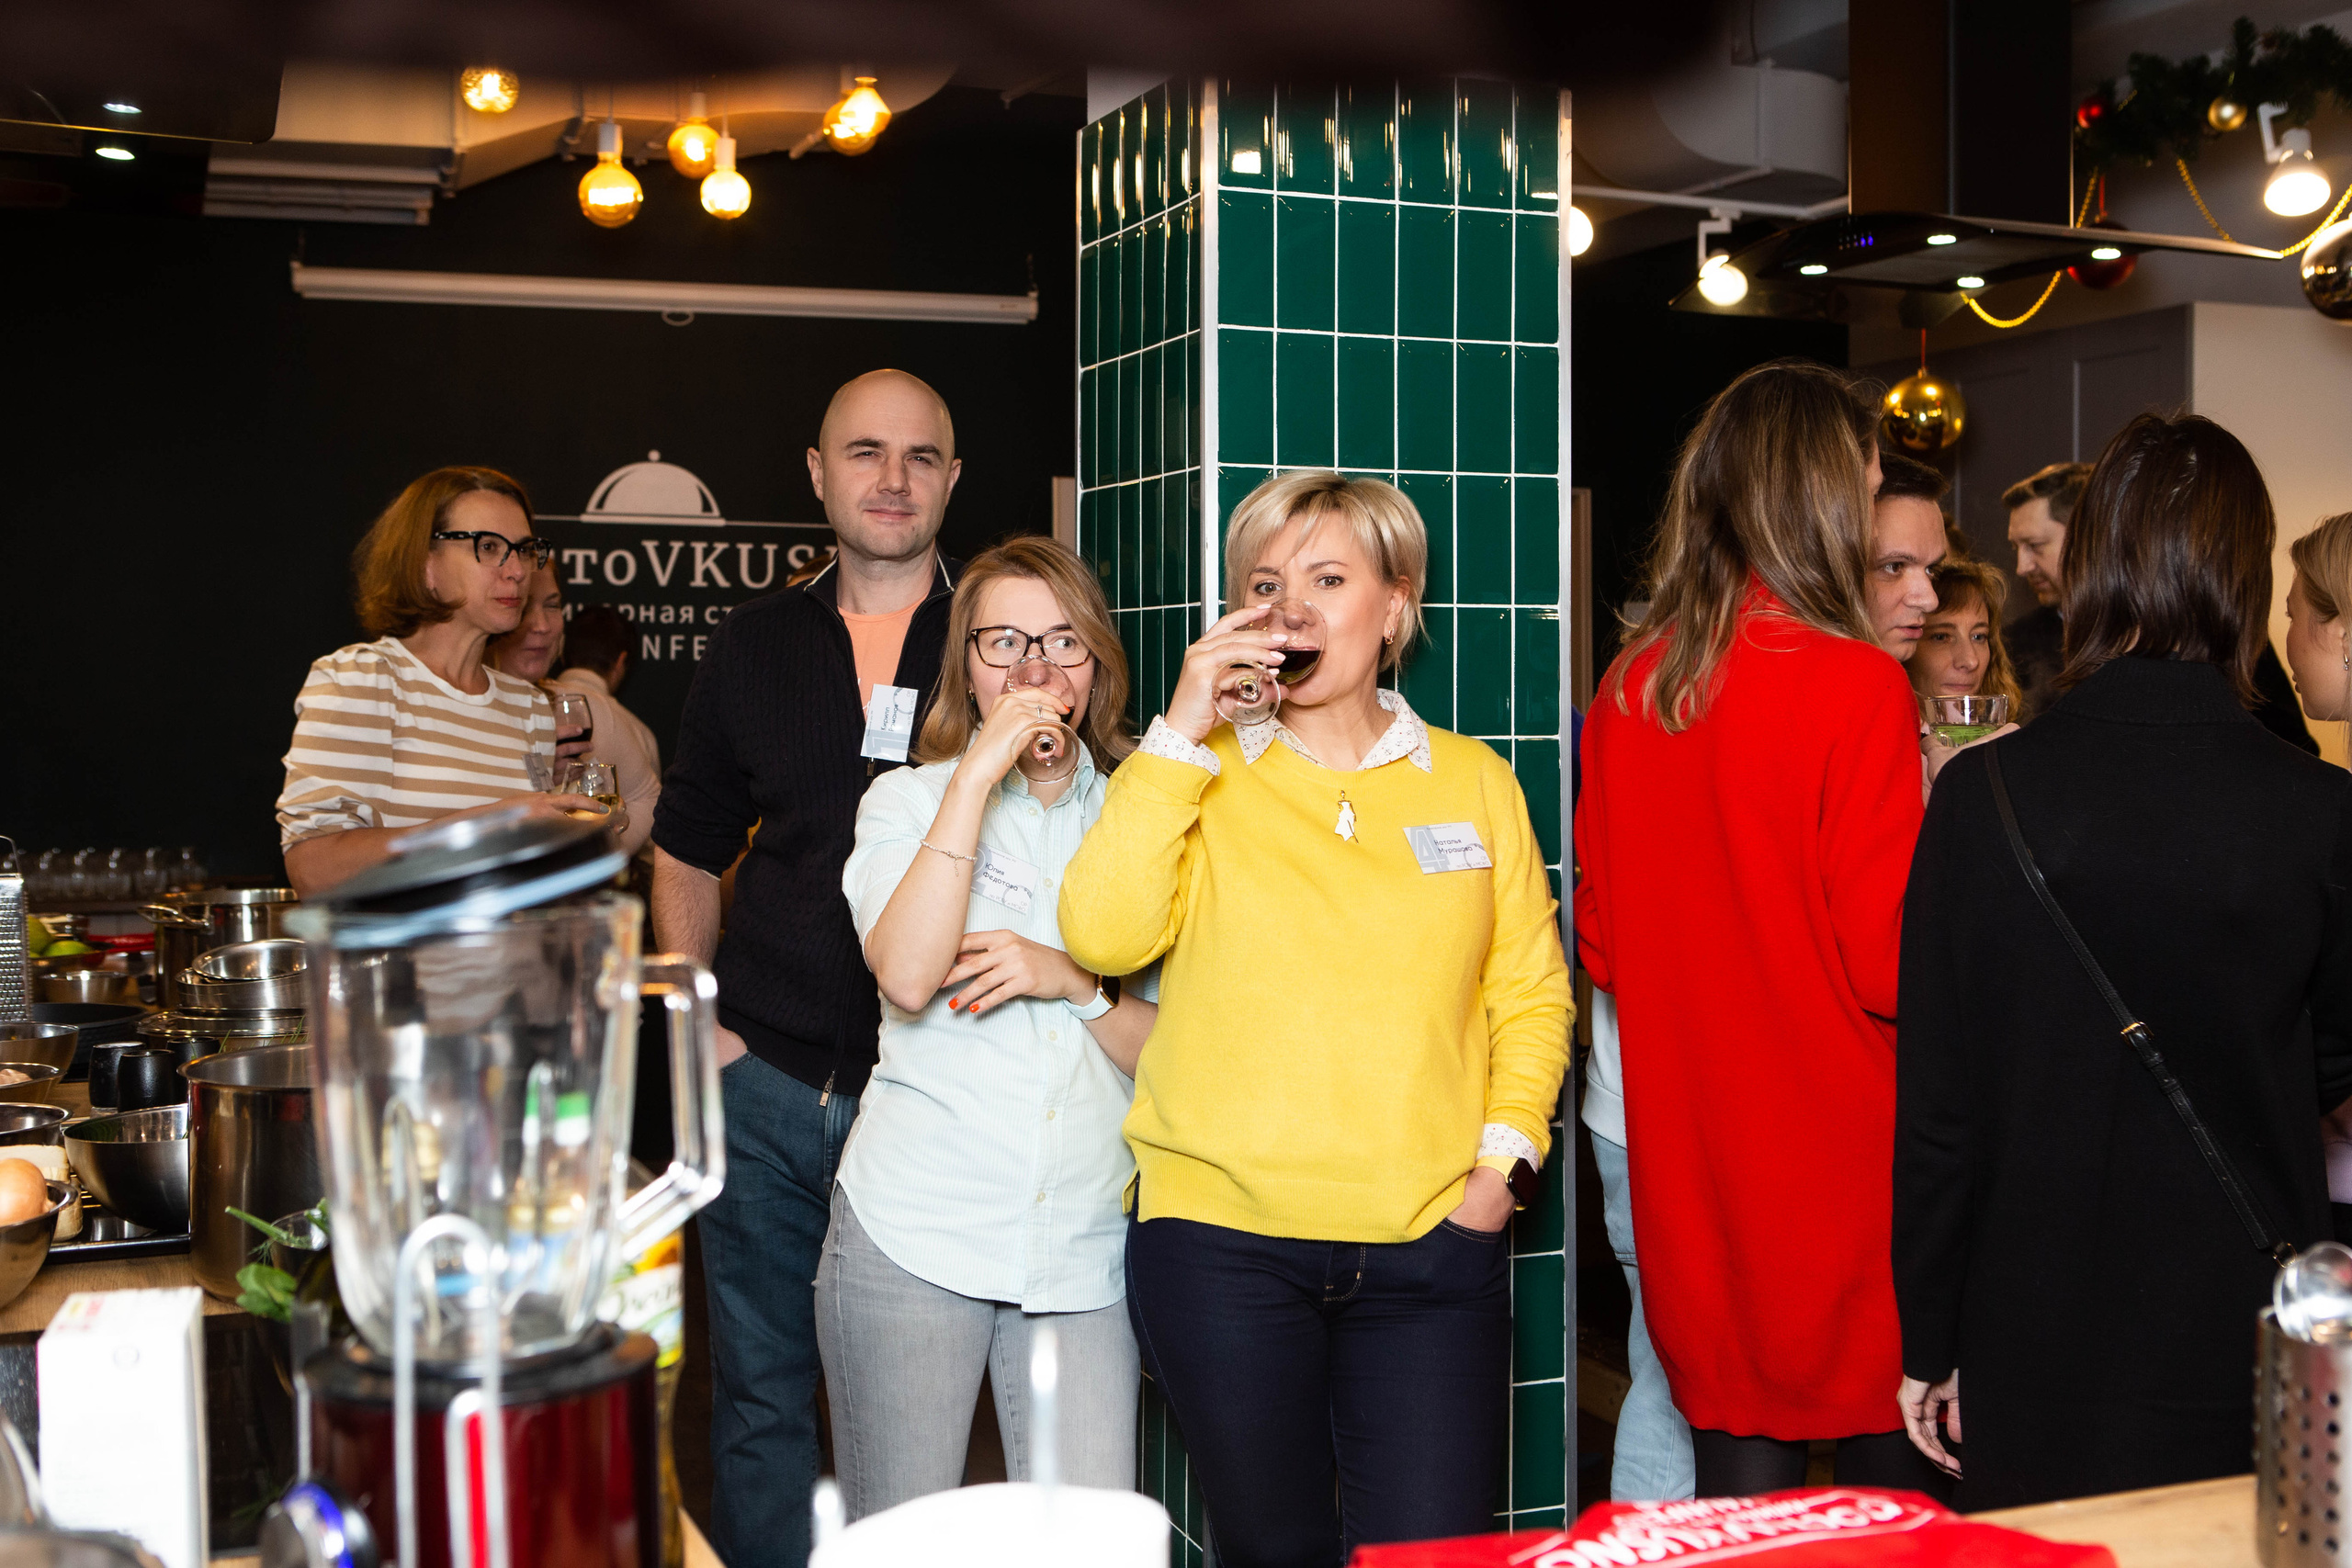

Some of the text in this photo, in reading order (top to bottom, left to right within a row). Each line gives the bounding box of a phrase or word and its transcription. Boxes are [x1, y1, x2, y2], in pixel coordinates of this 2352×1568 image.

[642, 634, 708, 661] NFE
[985, 862, 1005, 875] Юлия
[982, 871, 1019, 892] Федотова
